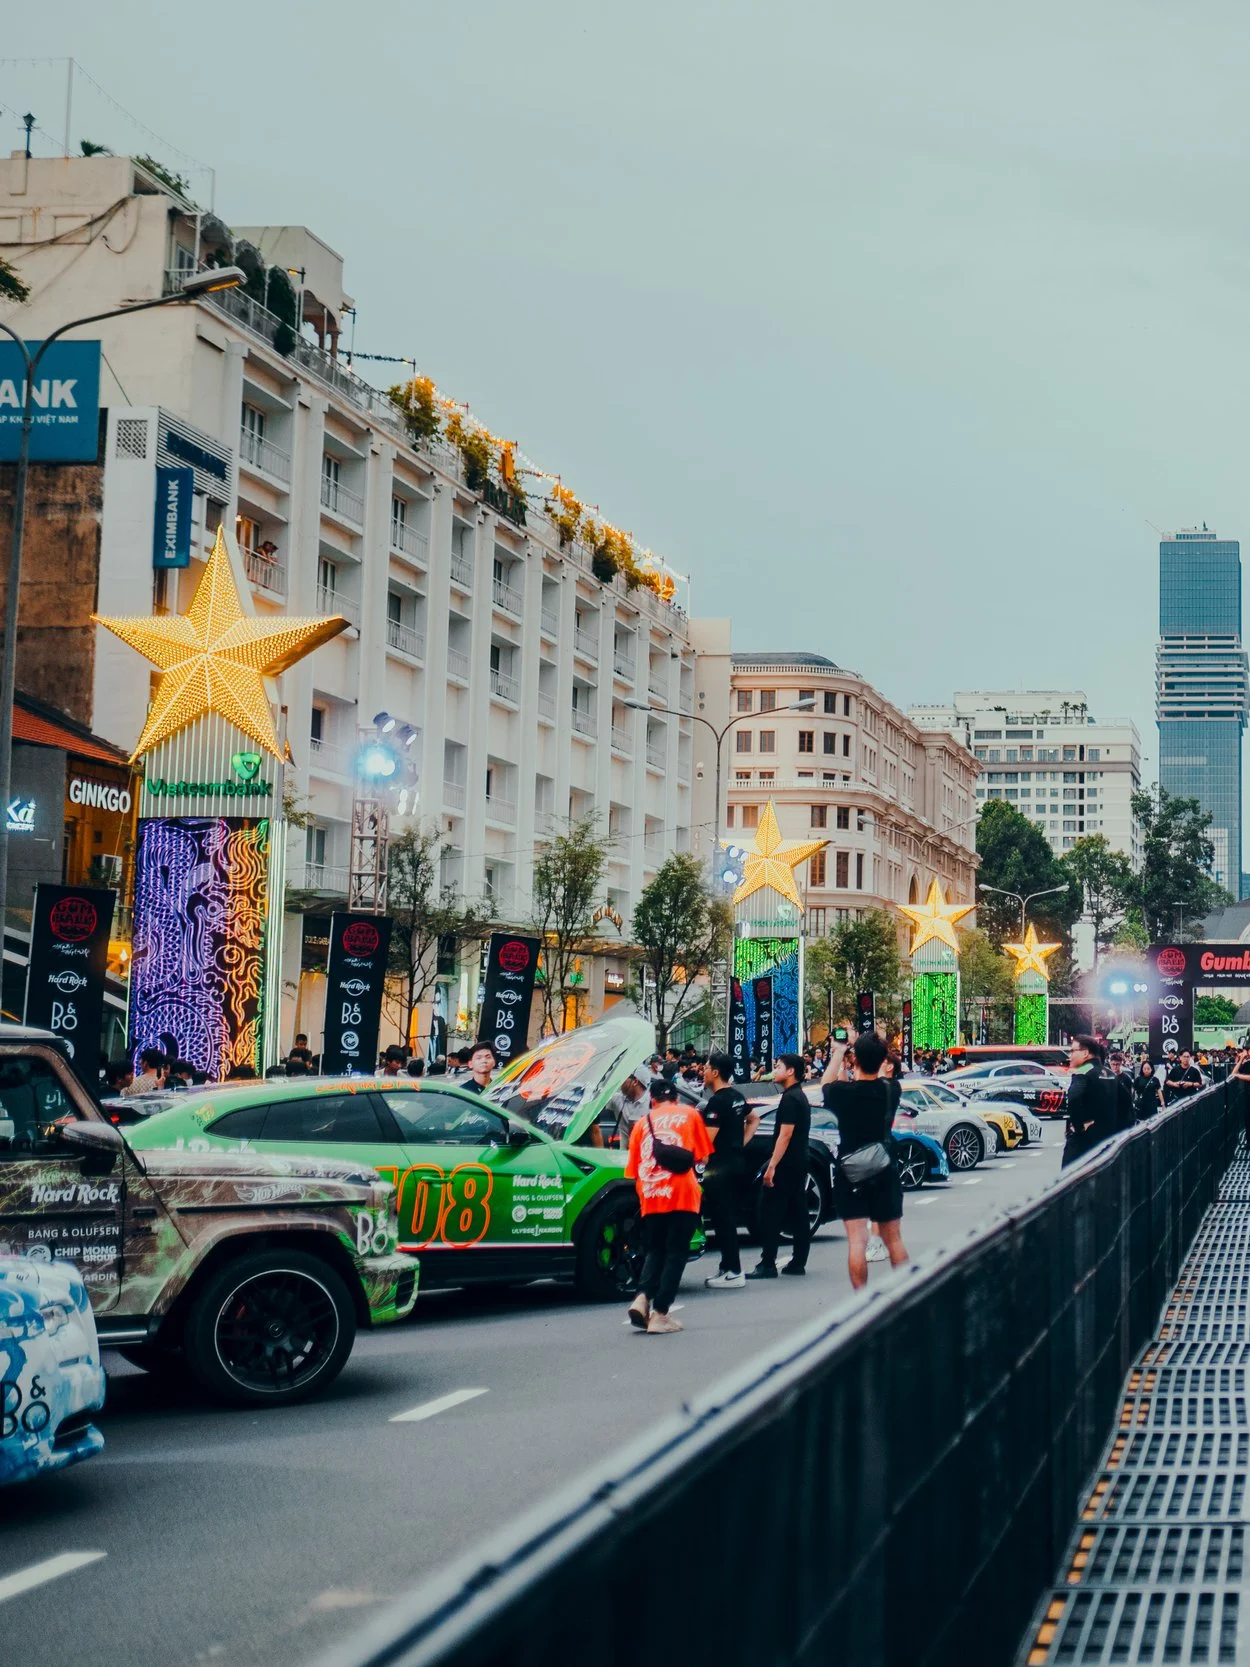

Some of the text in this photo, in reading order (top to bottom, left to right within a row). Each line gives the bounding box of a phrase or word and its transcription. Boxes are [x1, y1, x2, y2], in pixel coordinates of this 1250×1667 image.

[164, 479, 180, 560] EXIMBANK
[147, 778, 273, 798] Vietcombank
[69, 780, 131, 814] GINKGO
[48, 974, 88, 987] Hard Rock
[513, 1173, 563, 1189] Hard Rock
[30, 1183, 76, 1203] Hard
[28, 1226, 120, 1239] BANG & OLUFSEN
[54, 1245, 117, 1257] CHIP MONG
[83, 1254, 117, 1263] GROUP
